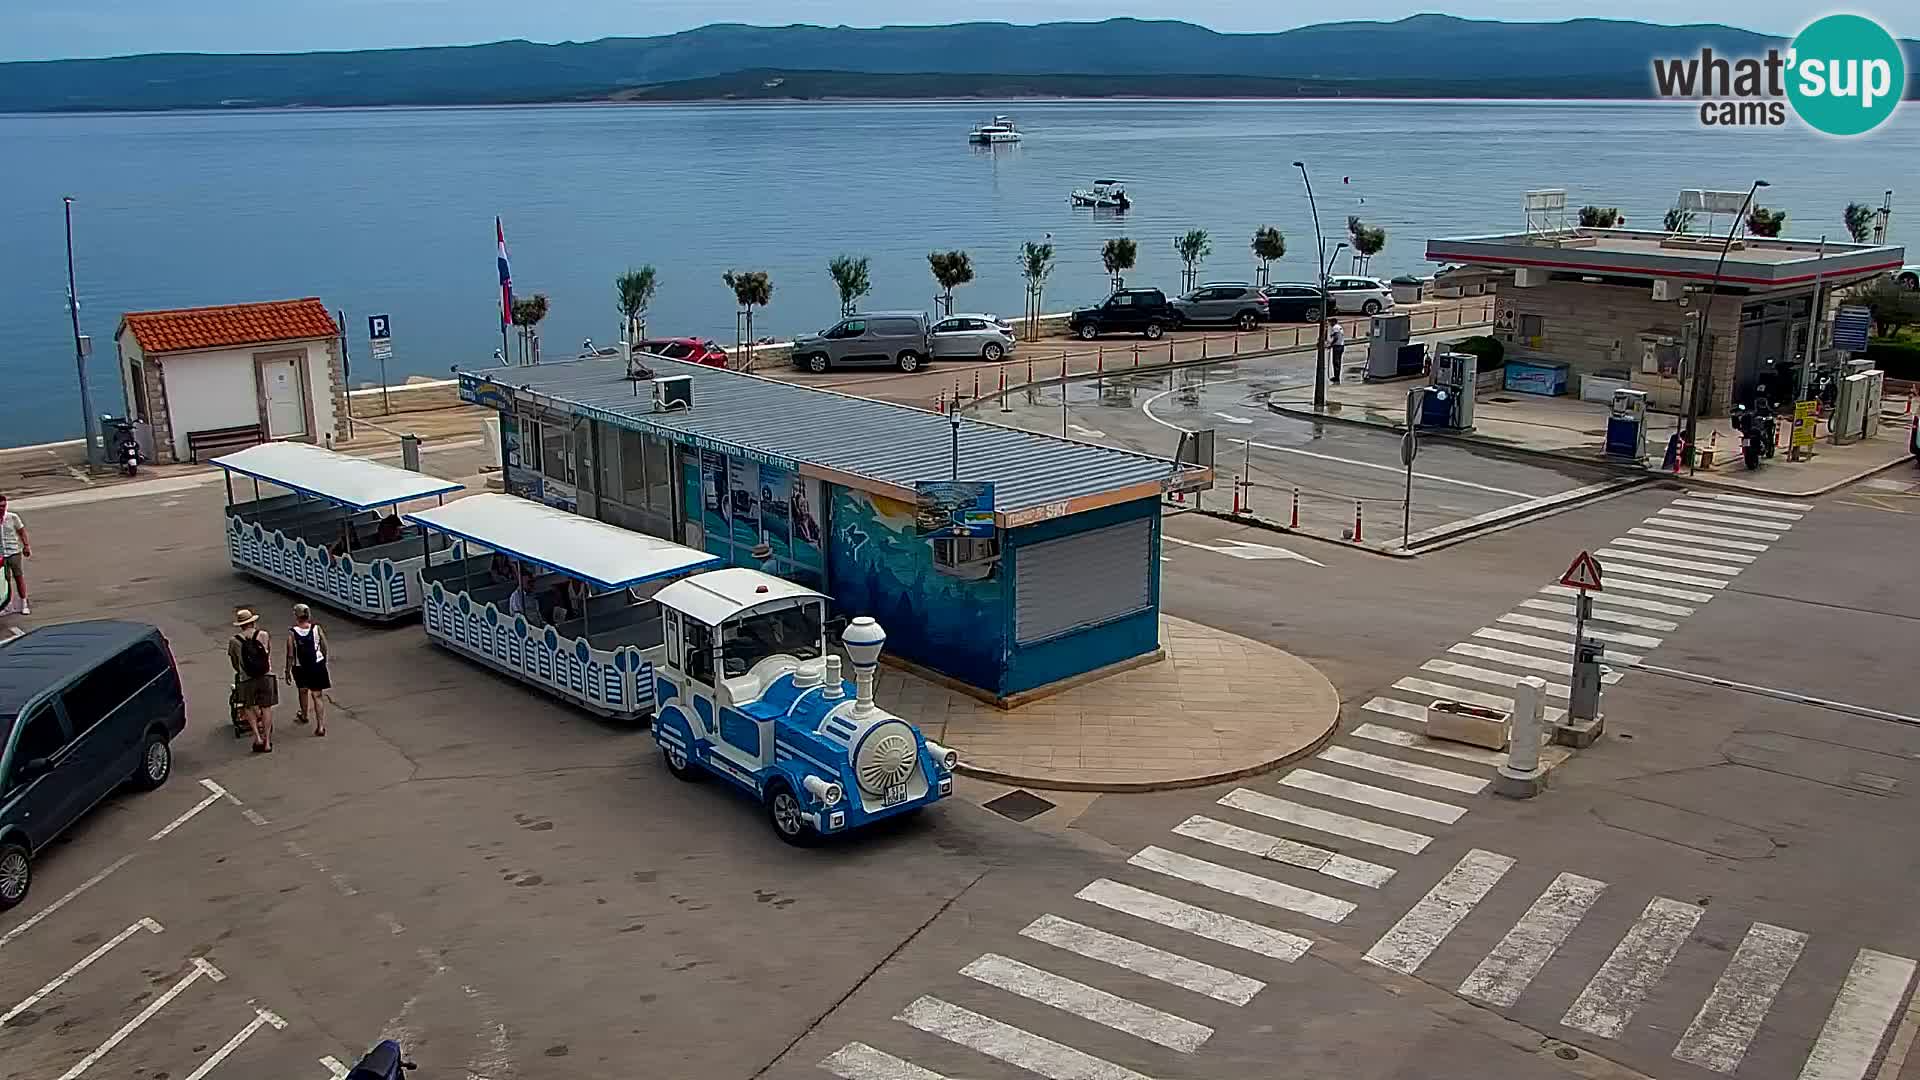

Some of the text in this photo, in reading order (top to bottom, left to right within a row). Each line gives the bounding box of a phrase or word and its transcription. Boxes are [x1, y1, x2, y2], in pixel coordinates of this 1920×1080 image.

[373, 318, 385, 336] P
[695, 436, 710, 449] BUS
[710, 440, 742, 457] STATION
[743, 449, 768, 465] TICKET
[769, 456, 795, 471] OFFICE
